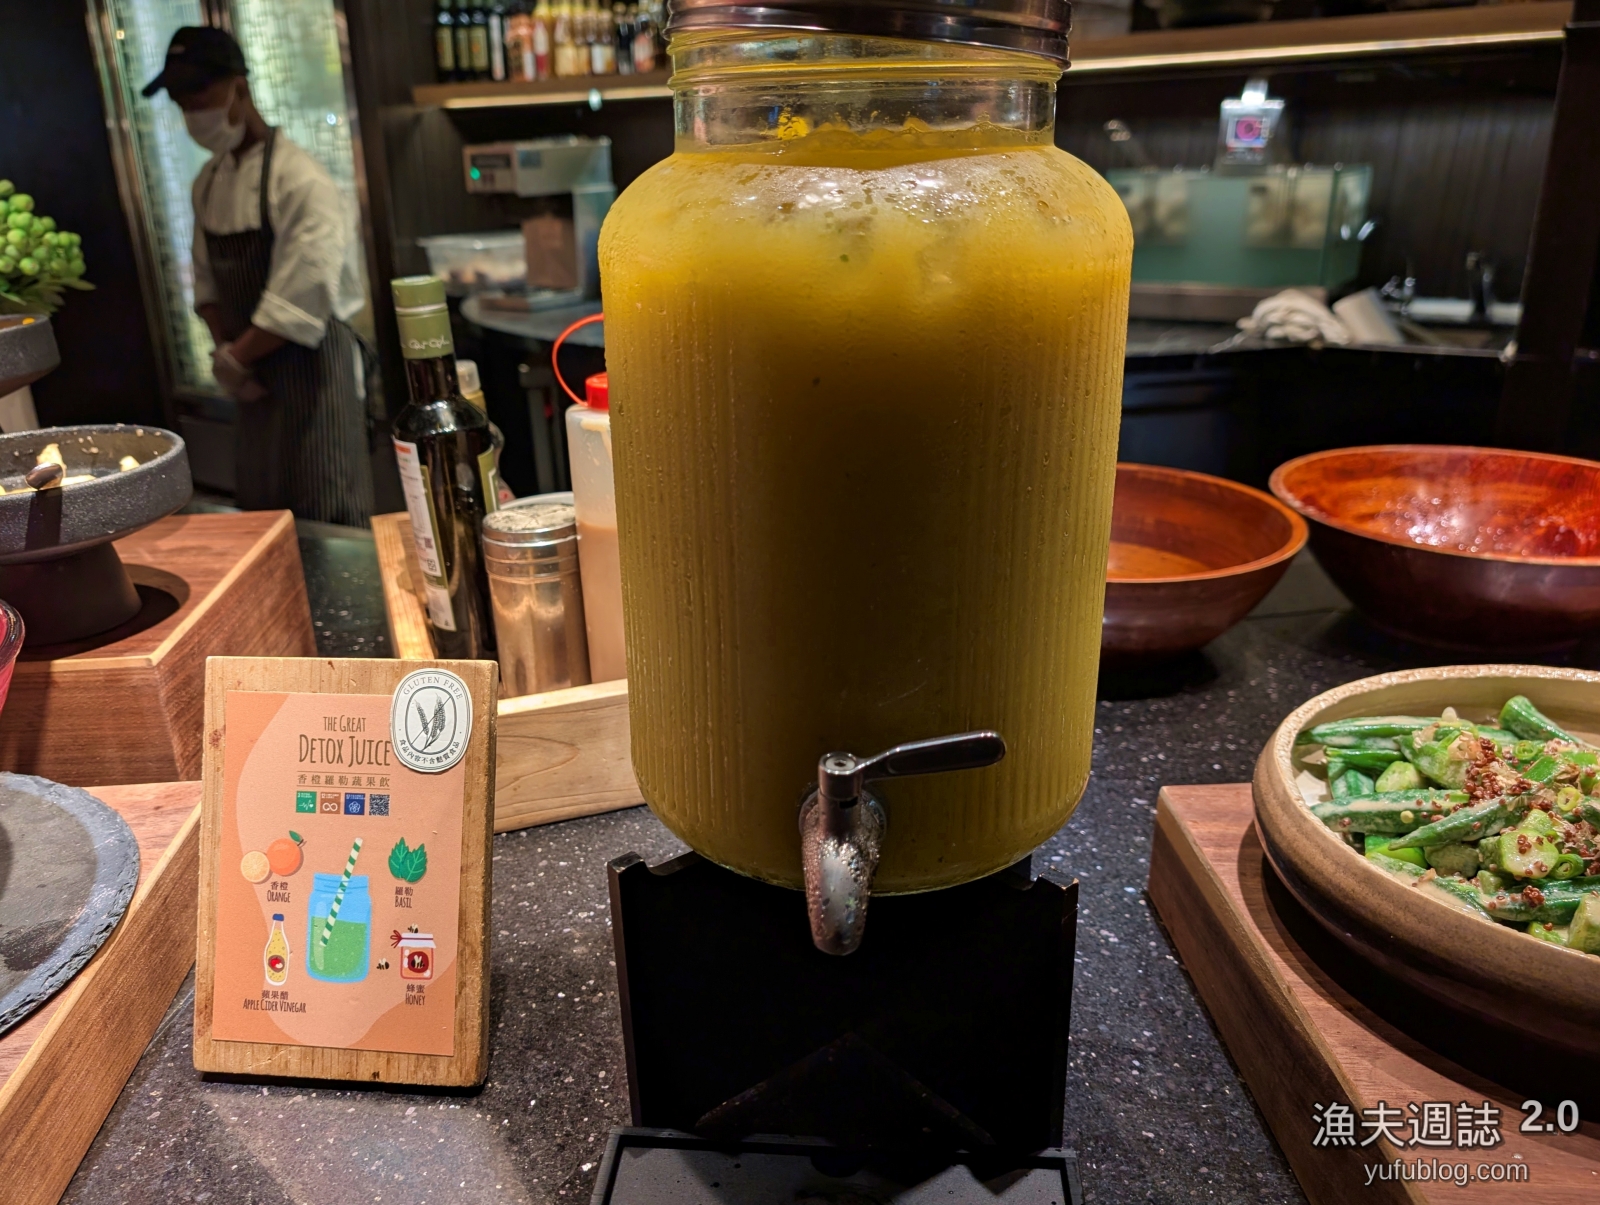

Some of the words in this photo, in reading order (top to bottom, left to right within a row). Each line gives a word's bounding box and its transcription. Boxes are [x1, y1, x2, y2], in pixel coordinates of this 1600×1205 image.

[403, 676, 440, 696] GLUTEN
[443, 679, 463, 700] FREE
[323, 716, 338, 732] THE
[339, 714, 367, 733] GREAT
[298, 734, 344, 765] DETOX
[347, 735, 391, 768] JUICE
[297, 774, 391, 788] 香橙羅勒蔬果飲
[270, 881, 289, 891] 香橙
[266, 889, 291, 903] ORANGE
[394, 895, 413, 909] BASIL
[242, 998, 260, 1011] APPLE
[260, 998, 279, 1012] CIDER
[279, 1000, 307, 1013] VINEGAR
[405, 992, 426, 1006] HONEY
